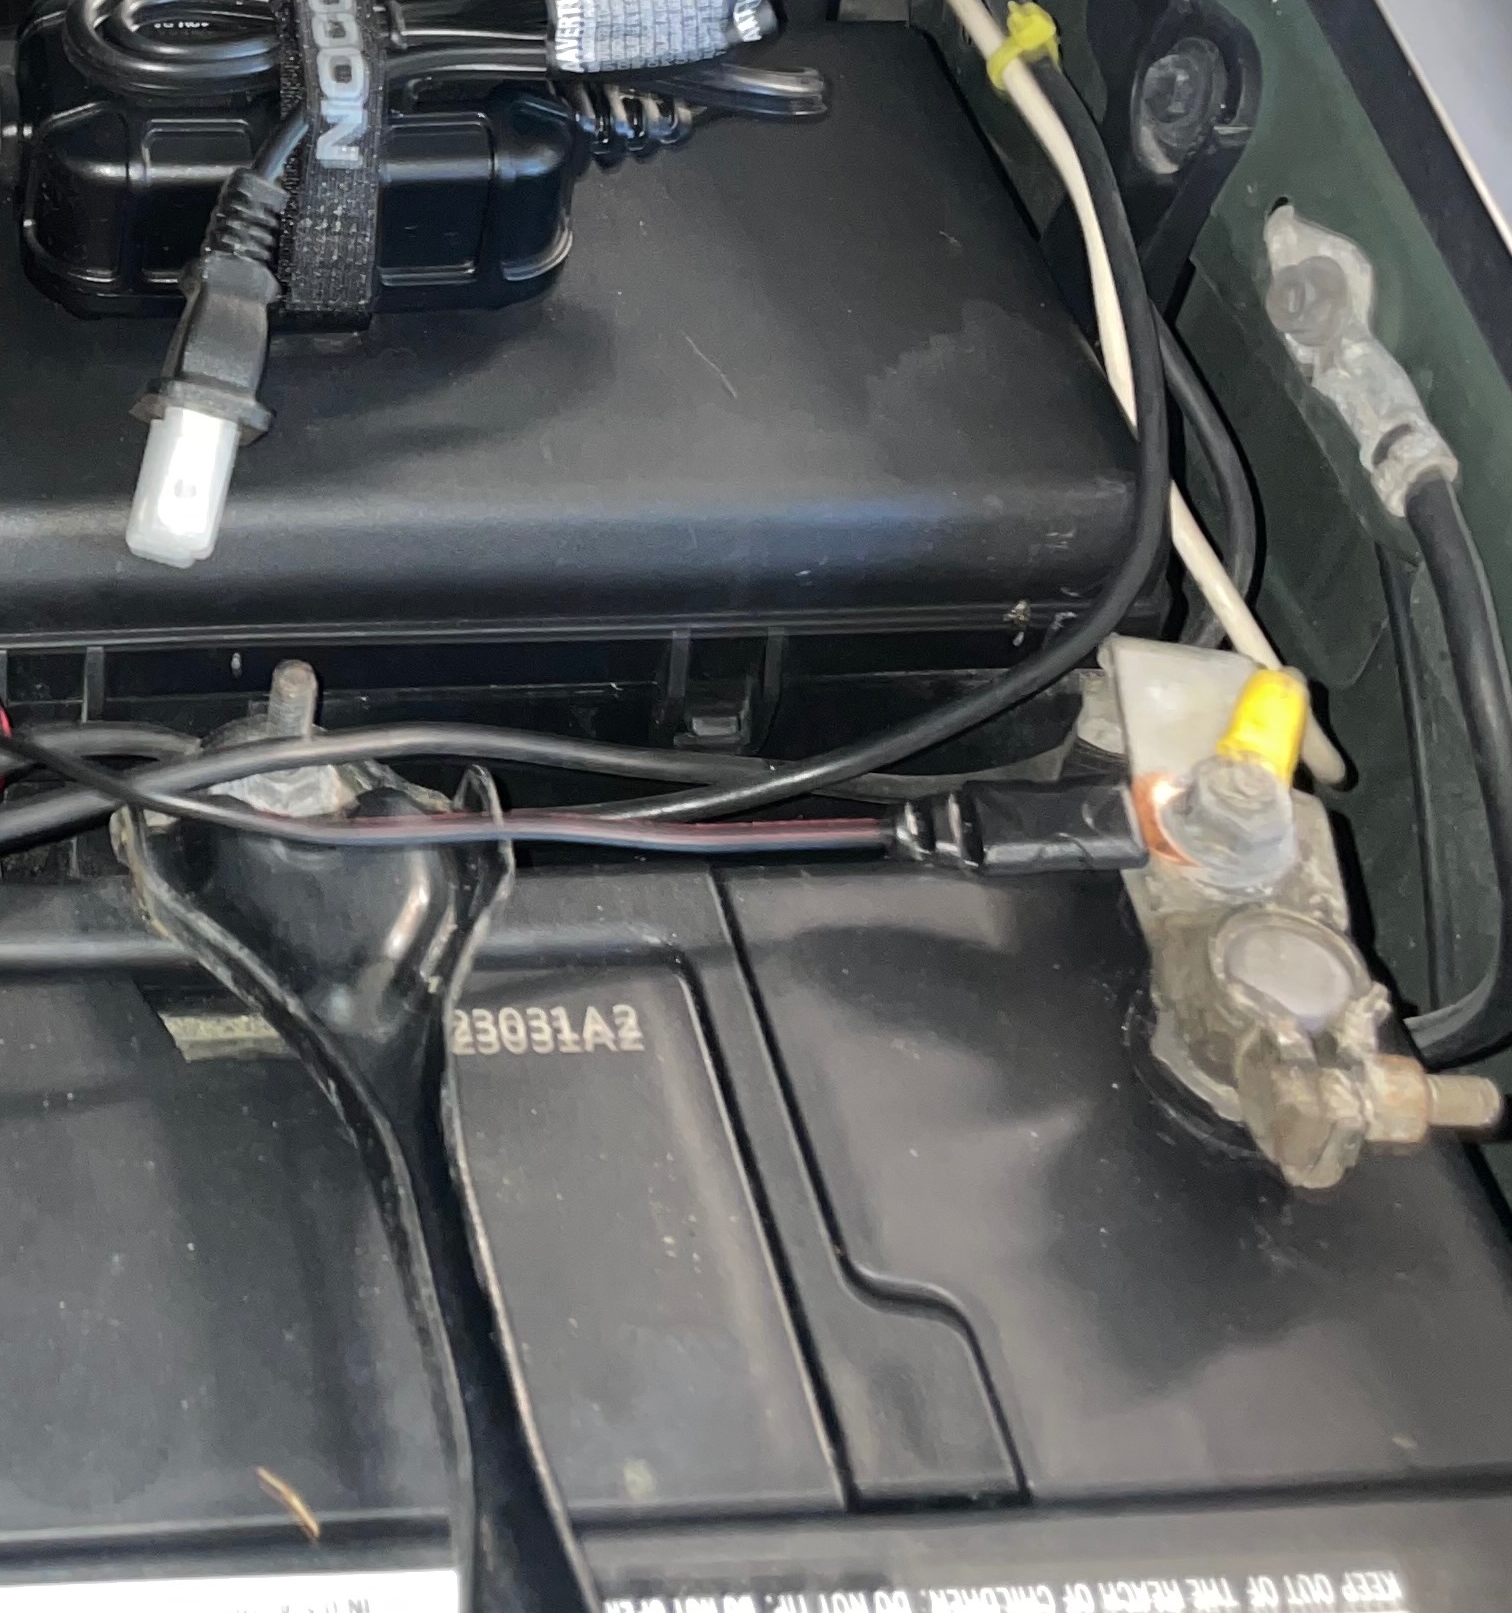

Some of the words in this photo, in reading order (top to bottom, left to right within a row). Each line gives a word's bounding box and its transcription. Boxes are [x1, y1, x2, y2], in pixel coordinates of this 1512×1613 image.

[1062, 1583, 1096, 1613] OF
[1098, 1578, 1185, 1613] REACH
[1185, 1577, 1239, 1610] THE
[1247, 1575, 1279, 1607] OF
[1283, 1573, 1336, 1605] OUT
[1341, 1570, 1403, 1602] KEEP
